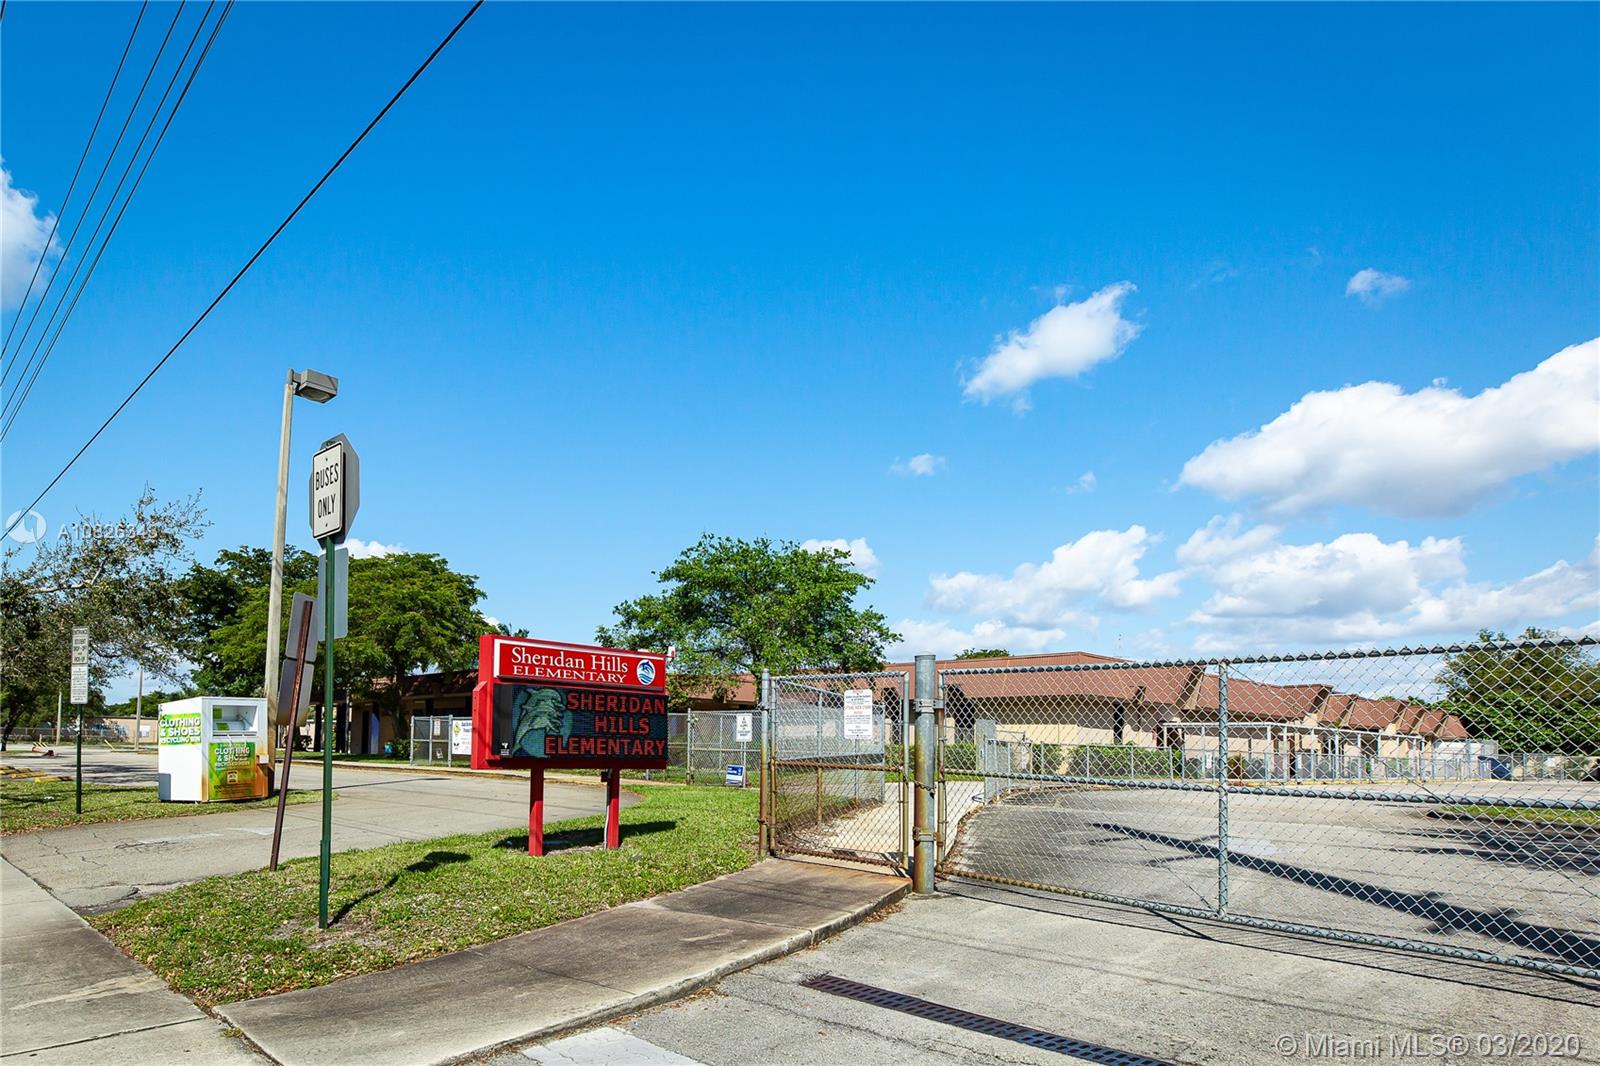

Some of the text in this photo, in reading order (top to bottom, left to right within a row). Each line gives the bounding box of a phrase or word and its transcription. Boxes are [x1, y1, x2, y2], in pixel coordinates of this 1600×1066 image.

[315, 462, 339, 491] BUSES
[317, 493, 336, 518] ONLY
[511, 647, 629, 673] Sheridan Hills
[512, 665, 627, 683] ELEMENTARY
[566, 692, 665, 714] SHERIDAN
[159, 717, 201, 728] CLOTHING
[169, 727, 200, 737] SHOES
[594, 716, 649, 735] HILLS
[545, 736, 666, 756] ELEMENTARY
